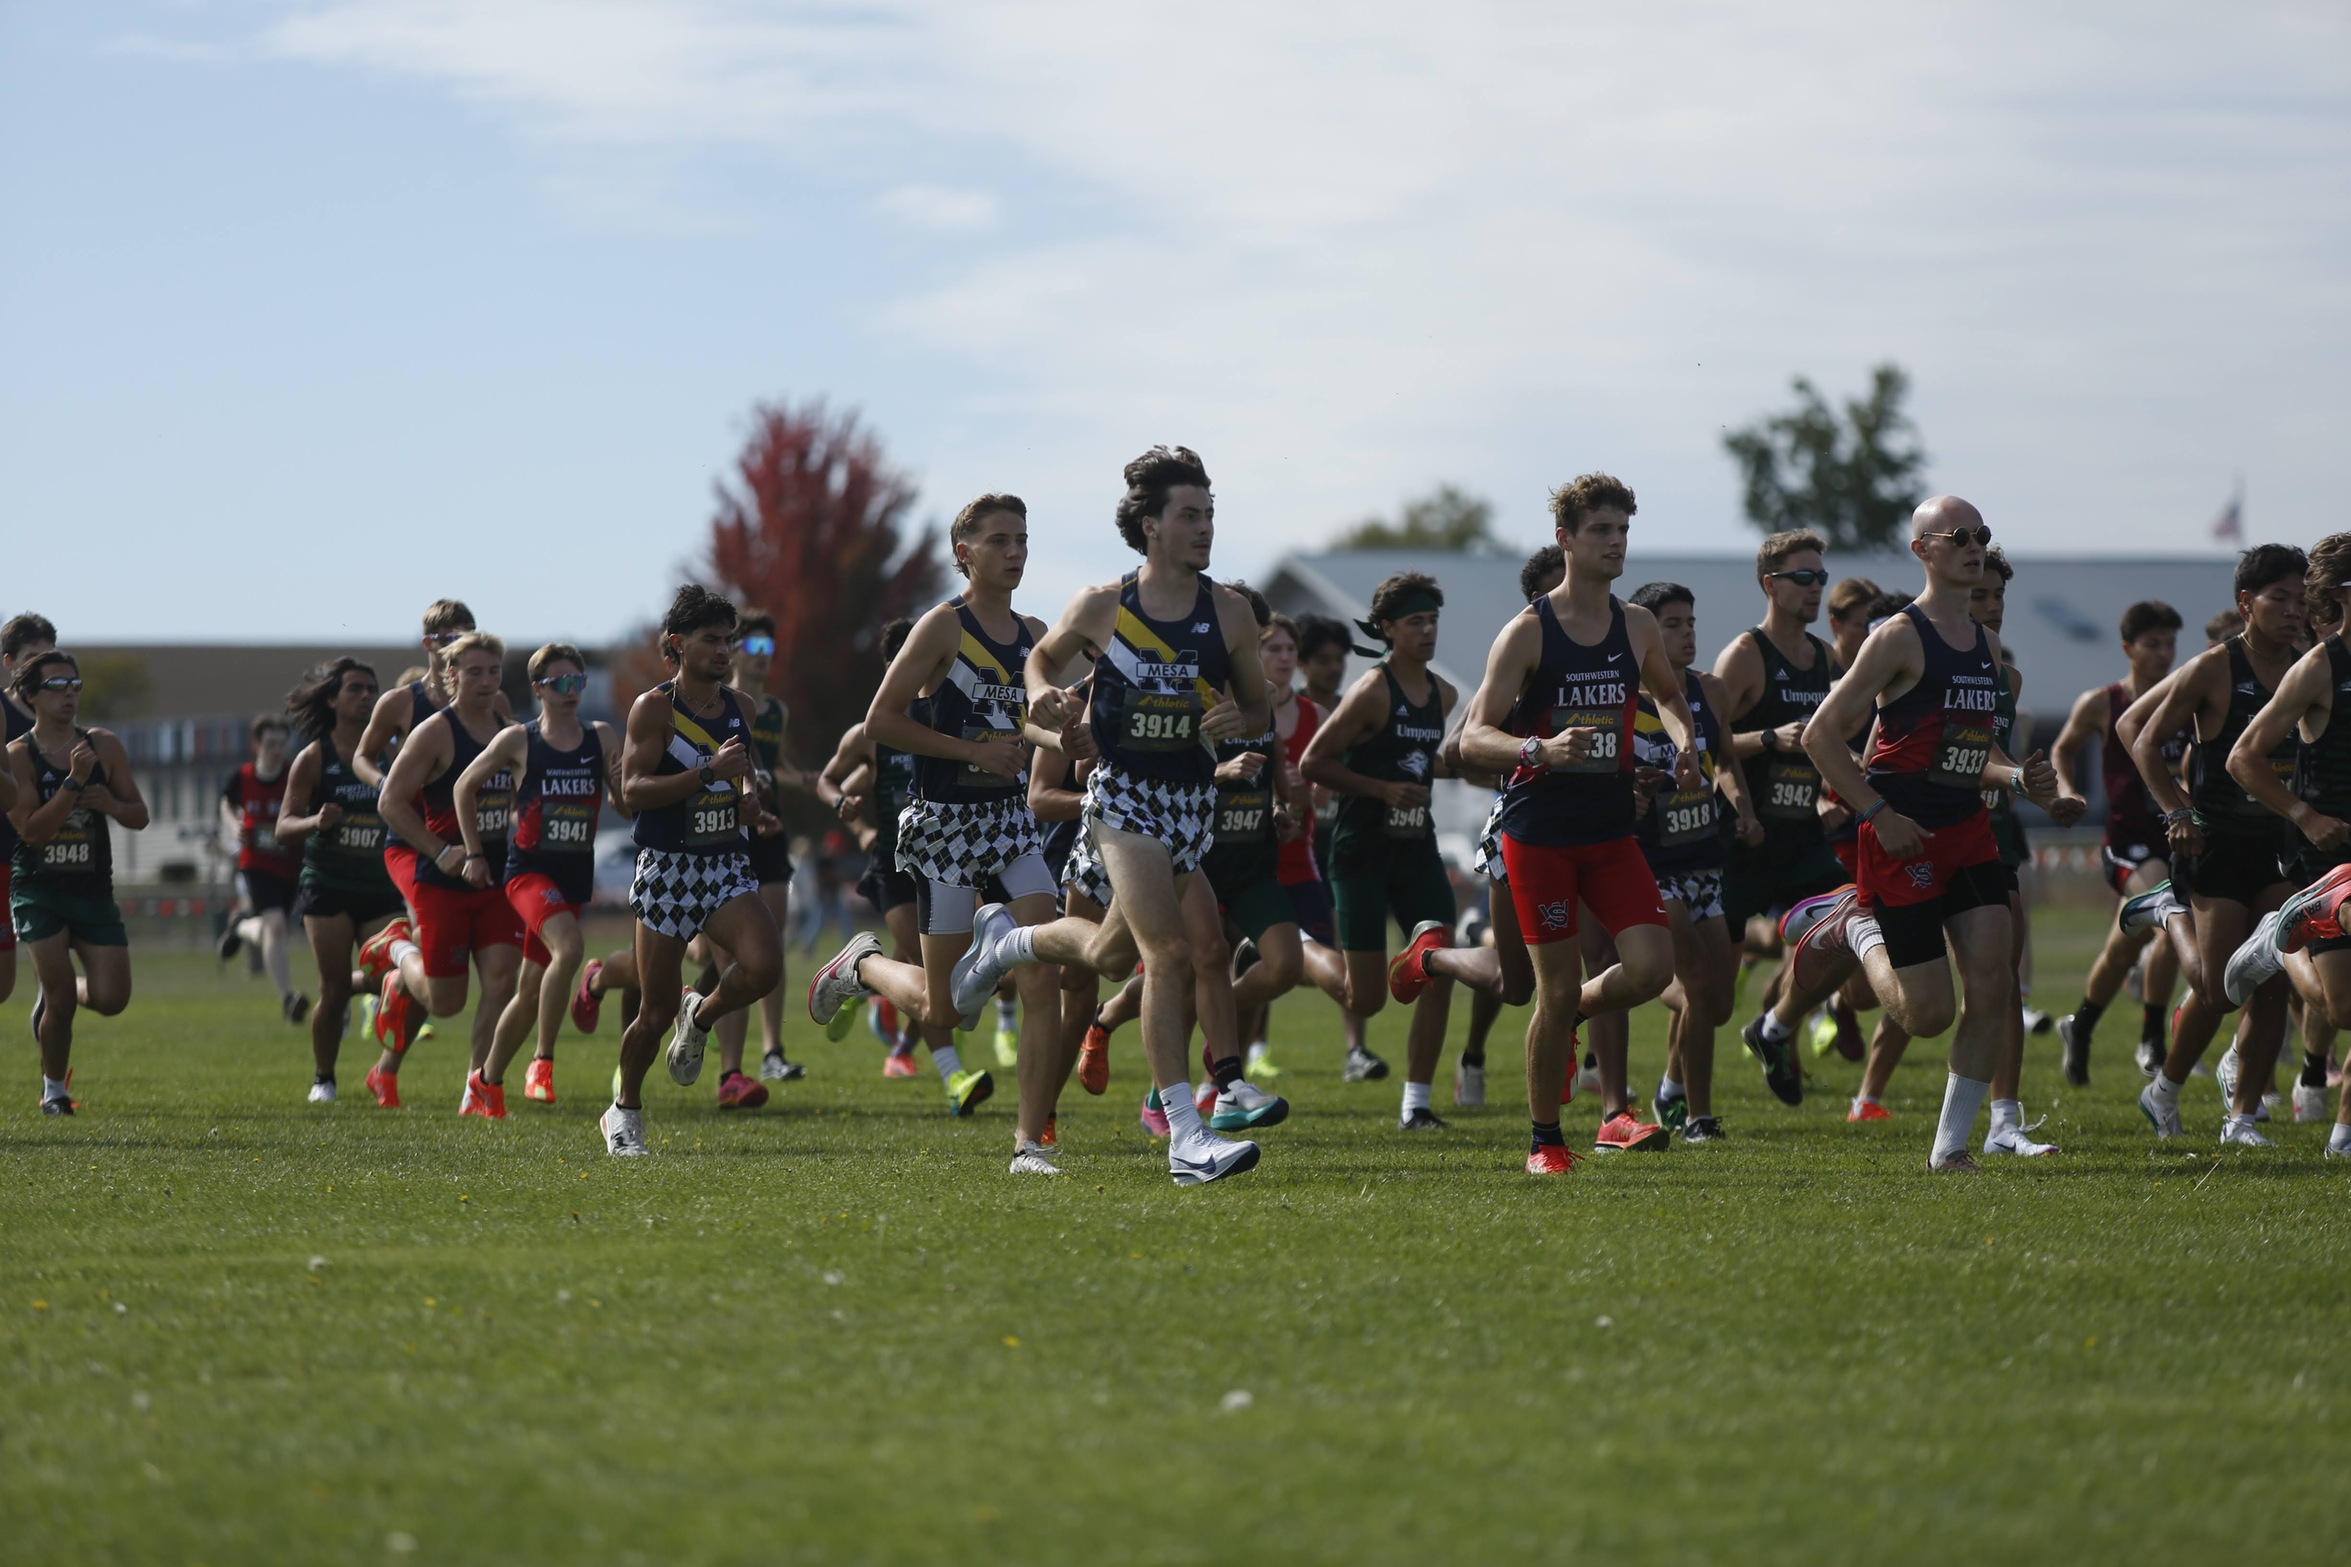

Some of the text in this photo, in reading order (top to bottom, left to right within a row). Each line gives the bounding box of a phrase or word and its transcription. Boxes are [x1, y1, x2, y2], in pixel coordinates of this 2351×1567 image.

[1148, 664, 1189, 678] MESA
[1565, 669, 1620, 683] SOUTHWESTERN
[1952, 674, 1994, 686] SOUTHWESTERN
[983, 685, 1018, 702] MESA
[1137, 695, 1190, 709] Athletic
[1558, 682, 1627, 707] LAKERS
[1781, 688, 1827, 706] Umpqu
[1943, 688, 1997, 712] LAKERS
[1130, 712, 1191, 739] 3914
[1566, 712, 1614, 725] Athletic
[1396, 723, 1441, 742] Umpqua
[541, 779, 596, 796] LAKERS
[1771, 782, 1813, 807] 3942
[694, 807, 736, 834] 3913
[1221, 809, 1264, 831] 3947
[1667, 803, 1711, 833] 3918
[339, 827, 381, 849] 3907
[547, 819, 588, 842] 3941
[44, 843, 90, 864] 3948
[2283, 900, 2323, 934] BROOKS
